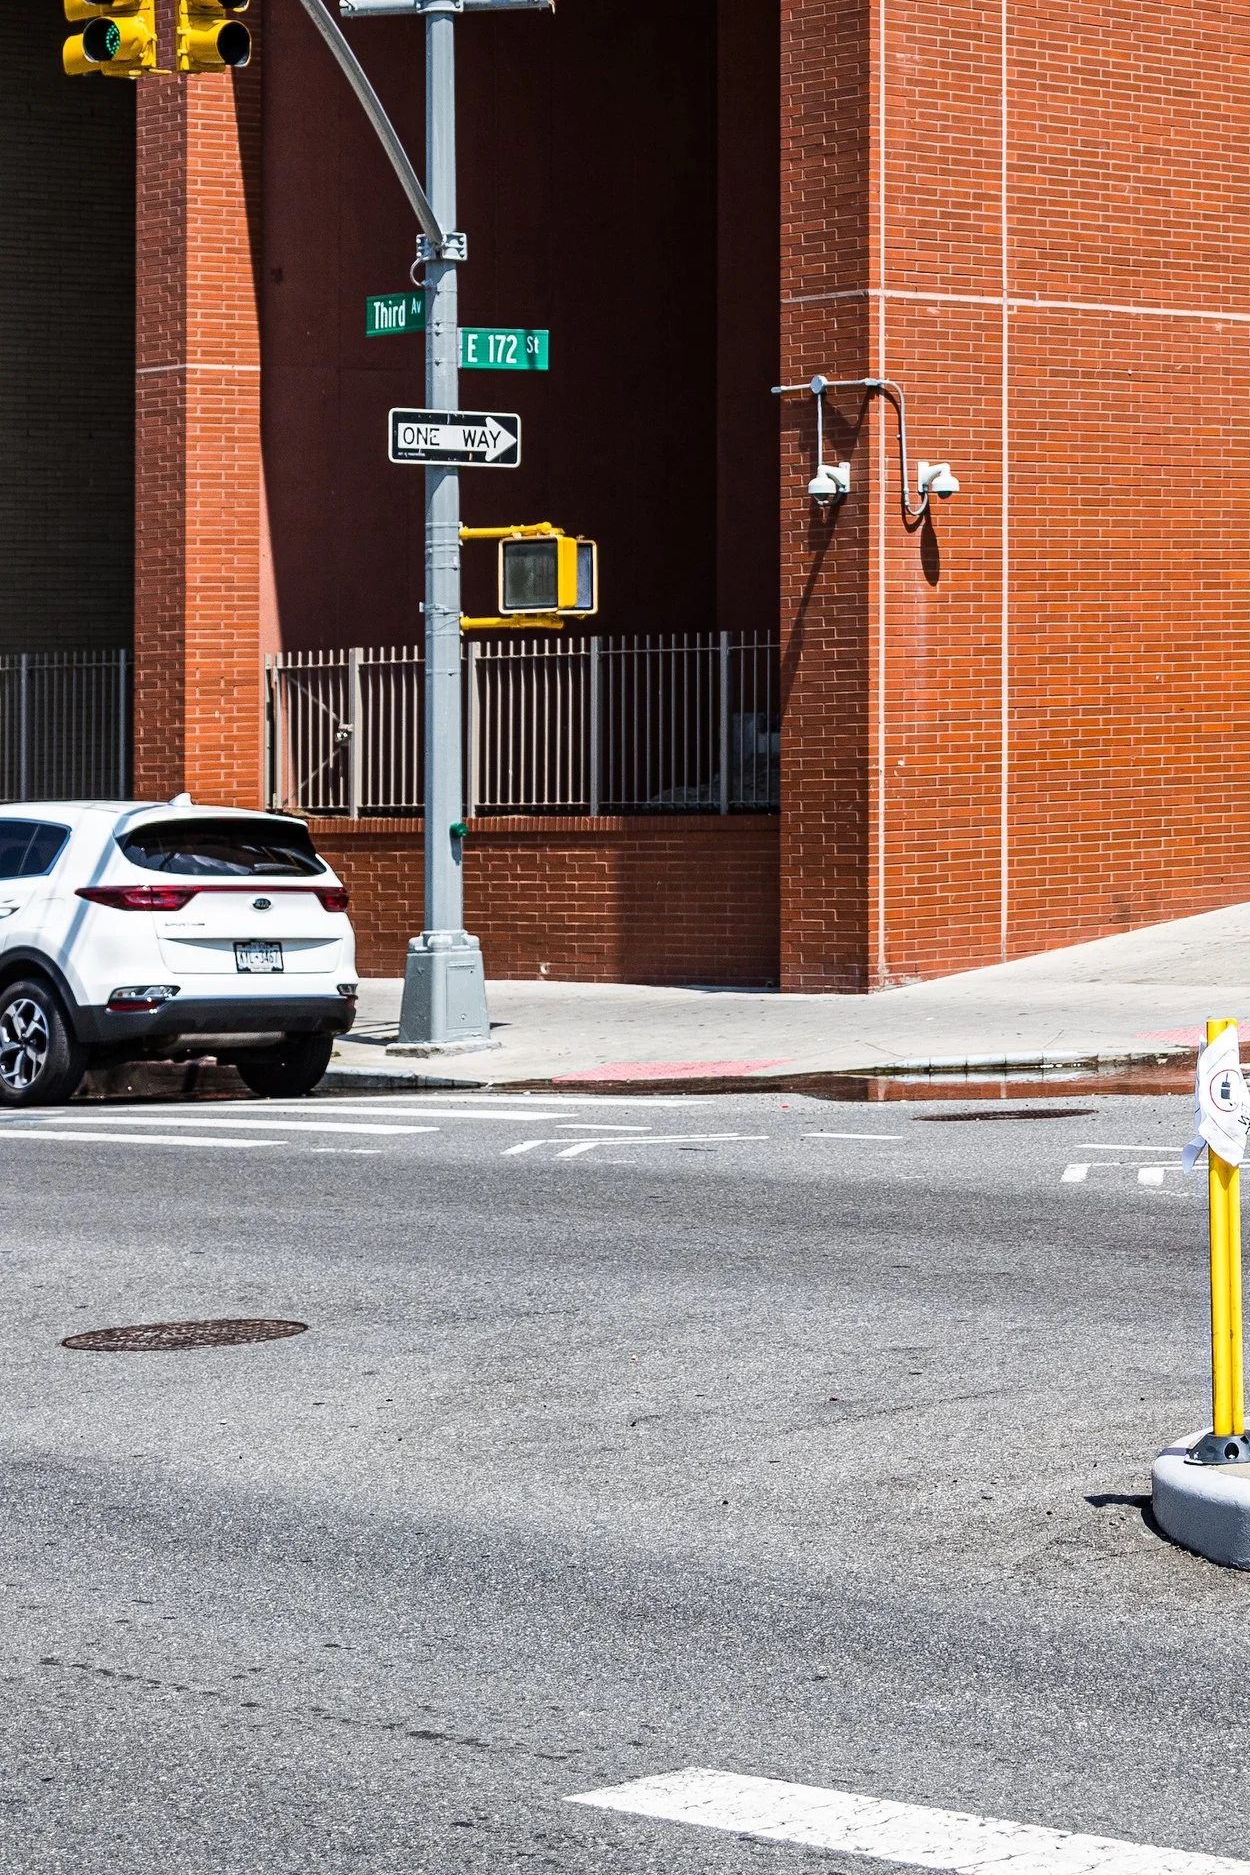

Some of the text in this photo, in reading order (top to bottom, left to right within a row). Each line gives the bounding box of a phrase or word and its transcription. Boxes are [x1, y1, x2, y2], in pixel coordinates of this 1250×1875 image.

[374, 297, 421, 329] Third Av
[467, 334, 539, 364] E 172 St
[403, 427, 501, 449] ONE WAY
